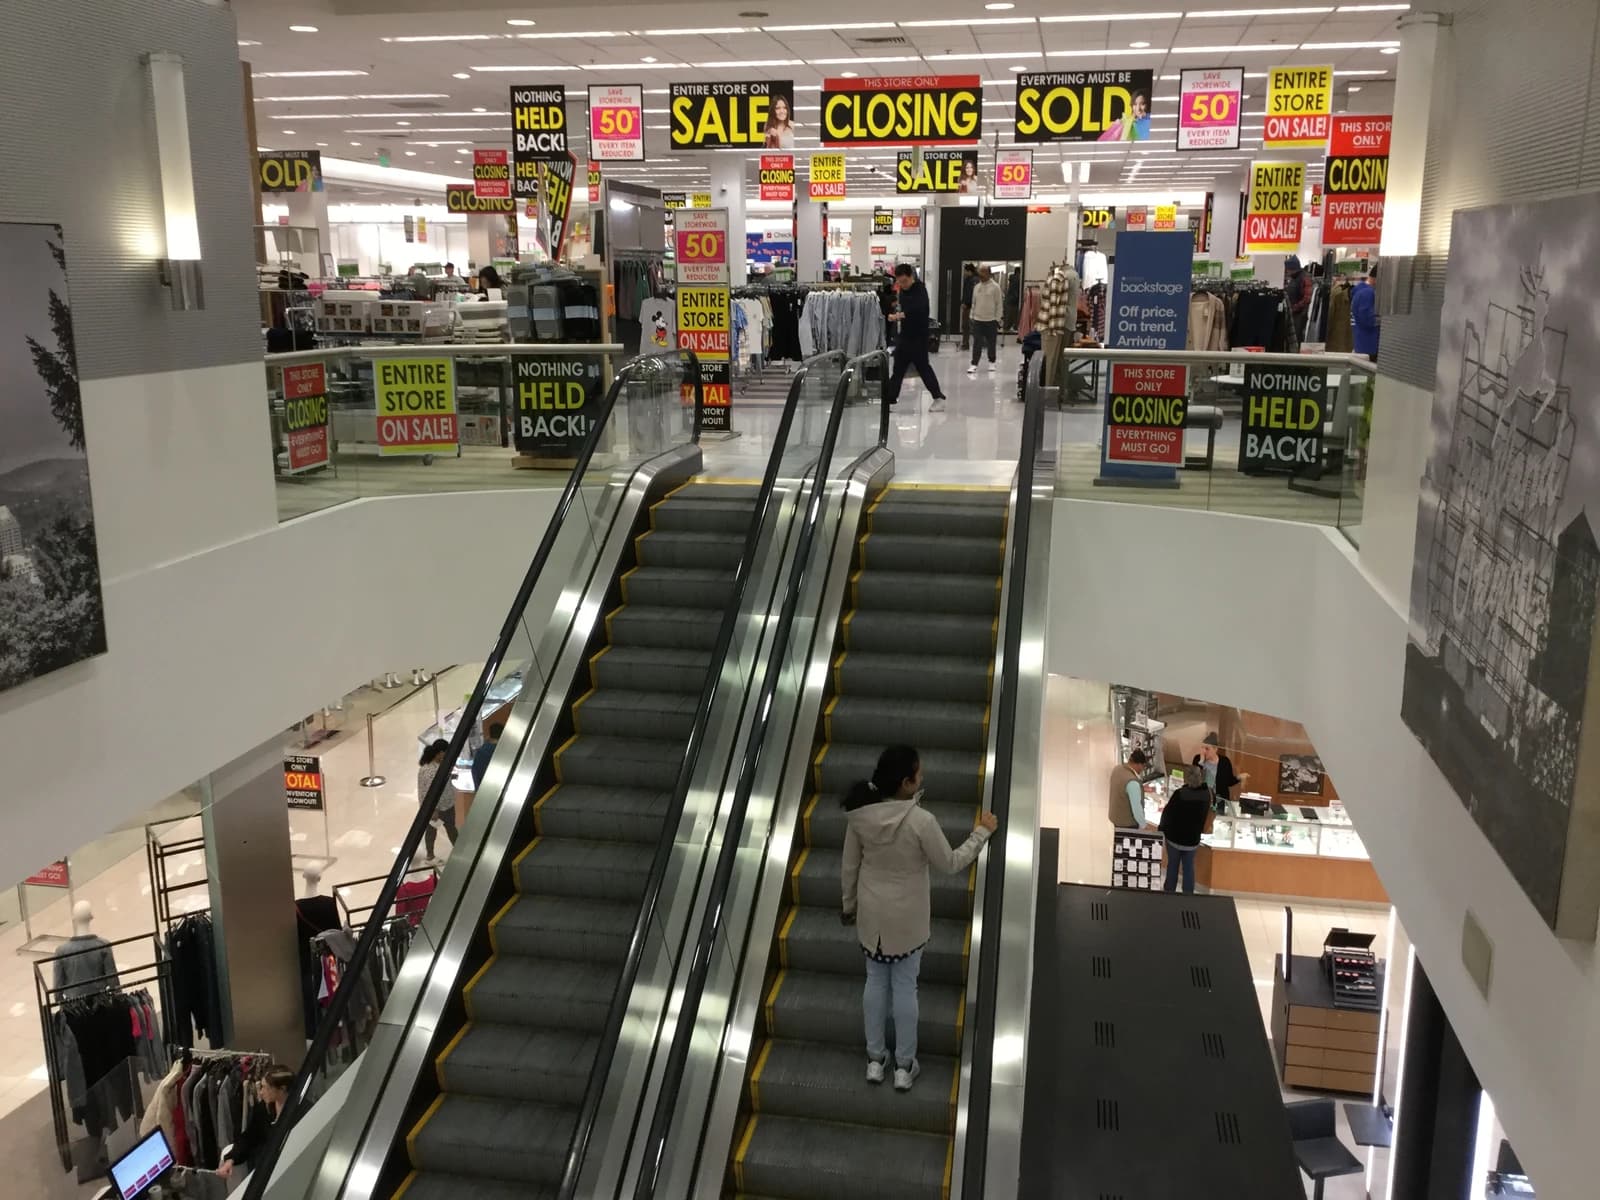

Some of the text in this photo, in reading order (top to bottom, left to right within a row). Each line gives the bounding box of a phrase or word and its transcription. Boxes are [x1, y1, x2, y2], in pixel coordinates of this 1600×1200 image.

[864, 77, 940, 88] THIS STORE ONLY
[1021, 72, 1131, 86] EVERYTHING MUST BE
[1203, 72, 1221, 80] SAVE
[1274, 71, 1327, 89] ENTIRE
[608, 88, 623, 96] SAVE
[673, 83, 769, 96] ENTIRE STORE ON
[1191, 81, 1231, 89] STOREWIDE
[514, 91, 562, 104] NOTHING
[599, 96, 632, 105] STOREWIDE
[1274, 93, 1324, 112] STORE
[825, 91, 978, 139] CLOSING
[1017, 86, 1133, 134] SOLD
[515, 106, 563, 130] HELD
[672, 96, 770, 145] SALE
[1267, 117, 1327, 138] ON SALE!
[1340, 121, 1391, 132] THIS STOR
[516, 133, 565, 152] BACK!
[599, 142, 618, 150] EVERY
[1189, 138, 1227, 146] REDUCED!
[1352, 135, 1383, 146] ONLY
[601, 150, 634, 158] REDUCED!
[925, 152, 948, 160] STORE
[813, 156, 842, 167] ENTIRE
[260, 160, 312, 187] OLD
[474, 166, 508, 178] CLOSING
[761, 170, 794, 183] CLOSING
[814, 170, 841, 180] STORE
[897, 160, 962, 191] SALE
[1255, 167, 1302, 187] ENTIRE
[1329, 158, 1388, 192] CLOSIN
[517, 180, 549, 192] BAC!
[811, 183, 844, 196] ON SALE!
[448, 191, 514, 211] CLOSING
[1254, 191, 1298, 211] STORE
[1329, 201, 1385, 215] EVERYTHIN
[875, 215, 892, 224] HELD
[985, 218, 1010, 226] rooms
[1082, 210, 1109, 226] OLD
[1334, 217, 1364, 230] MUST
[1250, 217, 1298, 239] ON SALE!
[1120, 281, 1183, 296] backstage
[682, 292, 725, 308] ENTIRE
[1120, 305, 1177, 319] Off price.
[683, 312, 724, 327] STORE
[1118, 320, 1177, 332] On trend.
[680, 333, 728, 351] ON SALE!
[1117, 335, 1167, 349] Arriving
[382, 364, 446, 385] ENTIRE
[518, 362, 584, 378] NOTHING
[701, 364, 722, 372] STORE
[1123, 368, 1175, 379] THIS STORE
[700, 373, 714, 381] NLY
[1250, 373, 1322, 392] NOTHING
[1135, 382, 1162, 391] ONLY
[385, 390, 446, 411] STORE
[519, 382, 585, 410] HELD
[287, 396, 326, 430] CLOSING
[1112, 396, 1184, 425] CLOSING
[1248, 396, 1320, 431] HELD
[382, 417, 453, 442] ON SALE!
[520, 414, 586, 438] BACK!
[1116, 429, 1177, 441] EVERYTHING
[1121, 442, 1170, 453] MUST GO!
[1246, 435, 1317, 464] BACK!
[285, 773, 319, 788] OTAL
